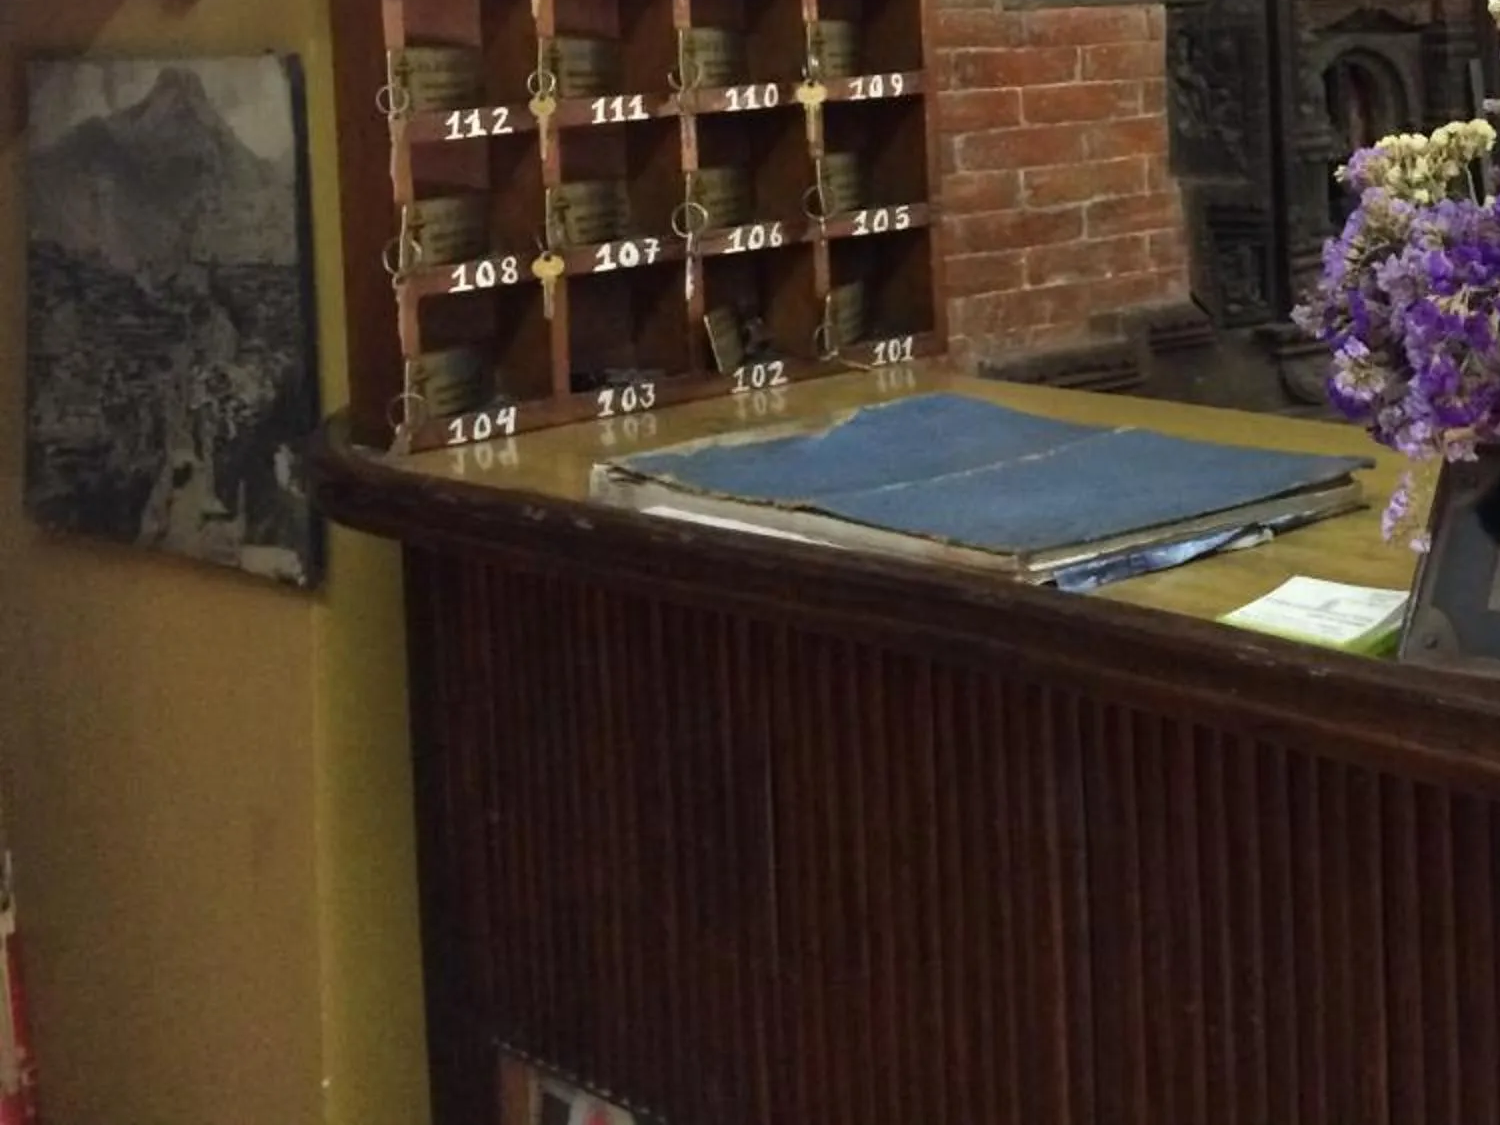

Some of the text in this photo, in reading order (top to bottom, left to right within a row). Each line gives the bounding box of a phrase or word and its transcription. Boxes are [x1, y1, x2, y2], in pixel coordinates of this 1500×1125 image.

[725, 83, 779, 112] 110
[848, 73, 904, 100] 109
[444, 106, 513, 140] 112
[591, 94, 649, 125] 111
[852, 205, 910, 236] 105
[722, 222, 783, 253] 106
[593, 238, 660, 272] 107
[448, 256, 518, 293] 108
[872, 336, 914, 365] 101
[731, 360, 788, 393] 102
[597, 383, 655, 418] 103
[447, 406, 518, 445] 104
